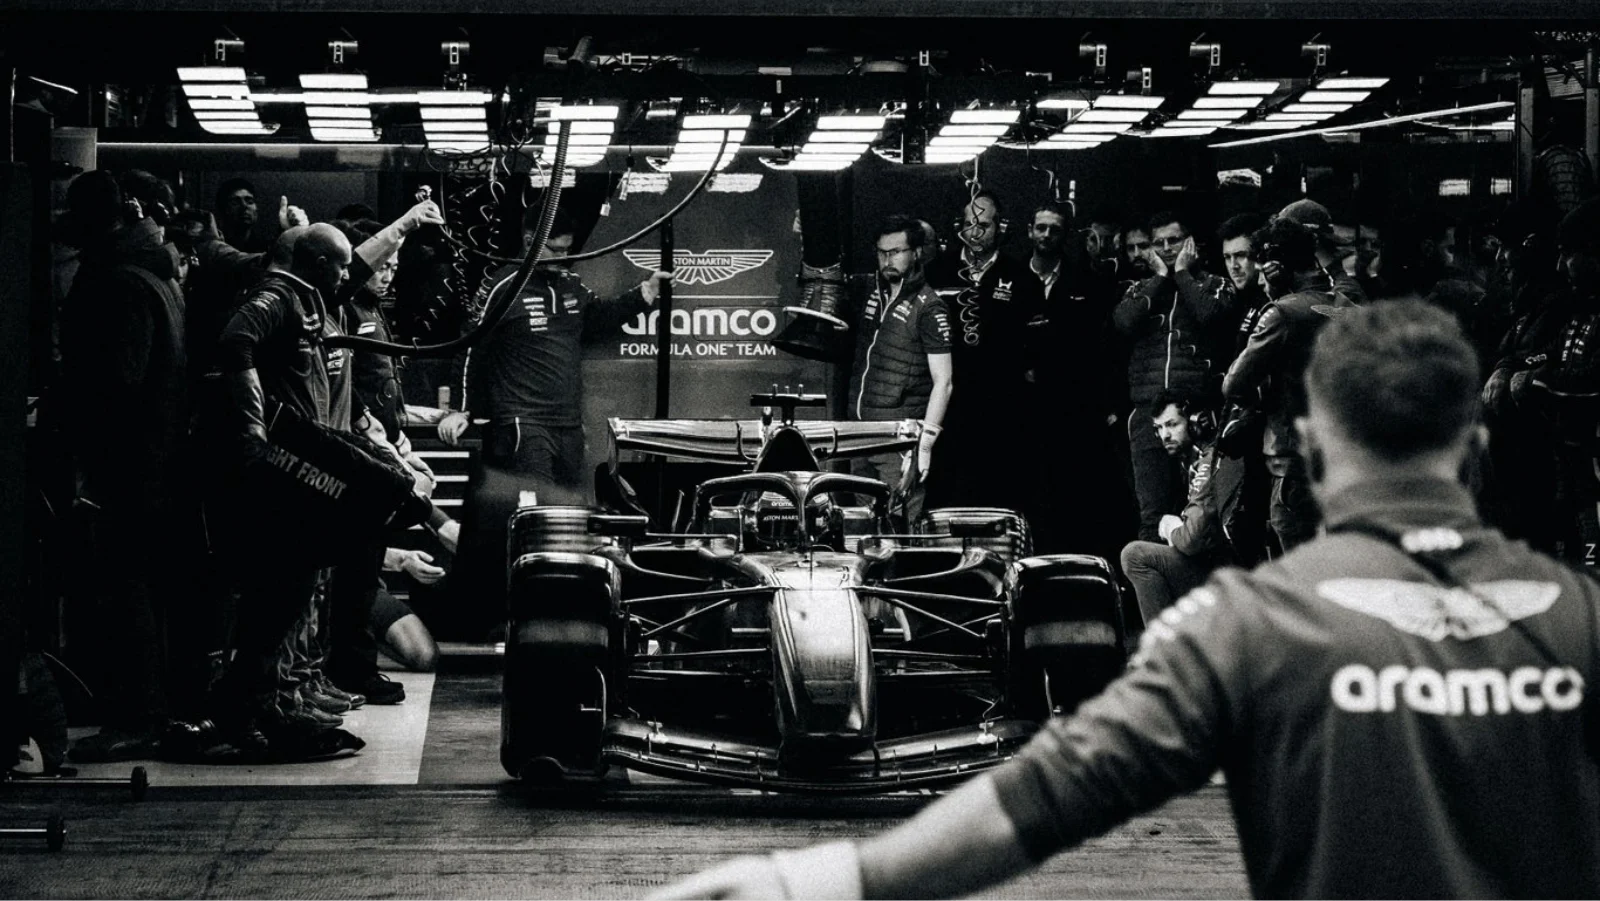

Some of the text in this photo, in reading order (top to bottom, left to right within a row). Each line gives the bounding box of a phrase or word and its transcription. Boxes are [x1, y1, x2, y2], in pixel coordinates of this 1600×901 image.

[673, 257, 730, 265] STON MARTIN
[736, 342, 776, 355] TEAM
[296, 461, 347, 499] FRONT
[1331, 664, 1585, 717] aramco
